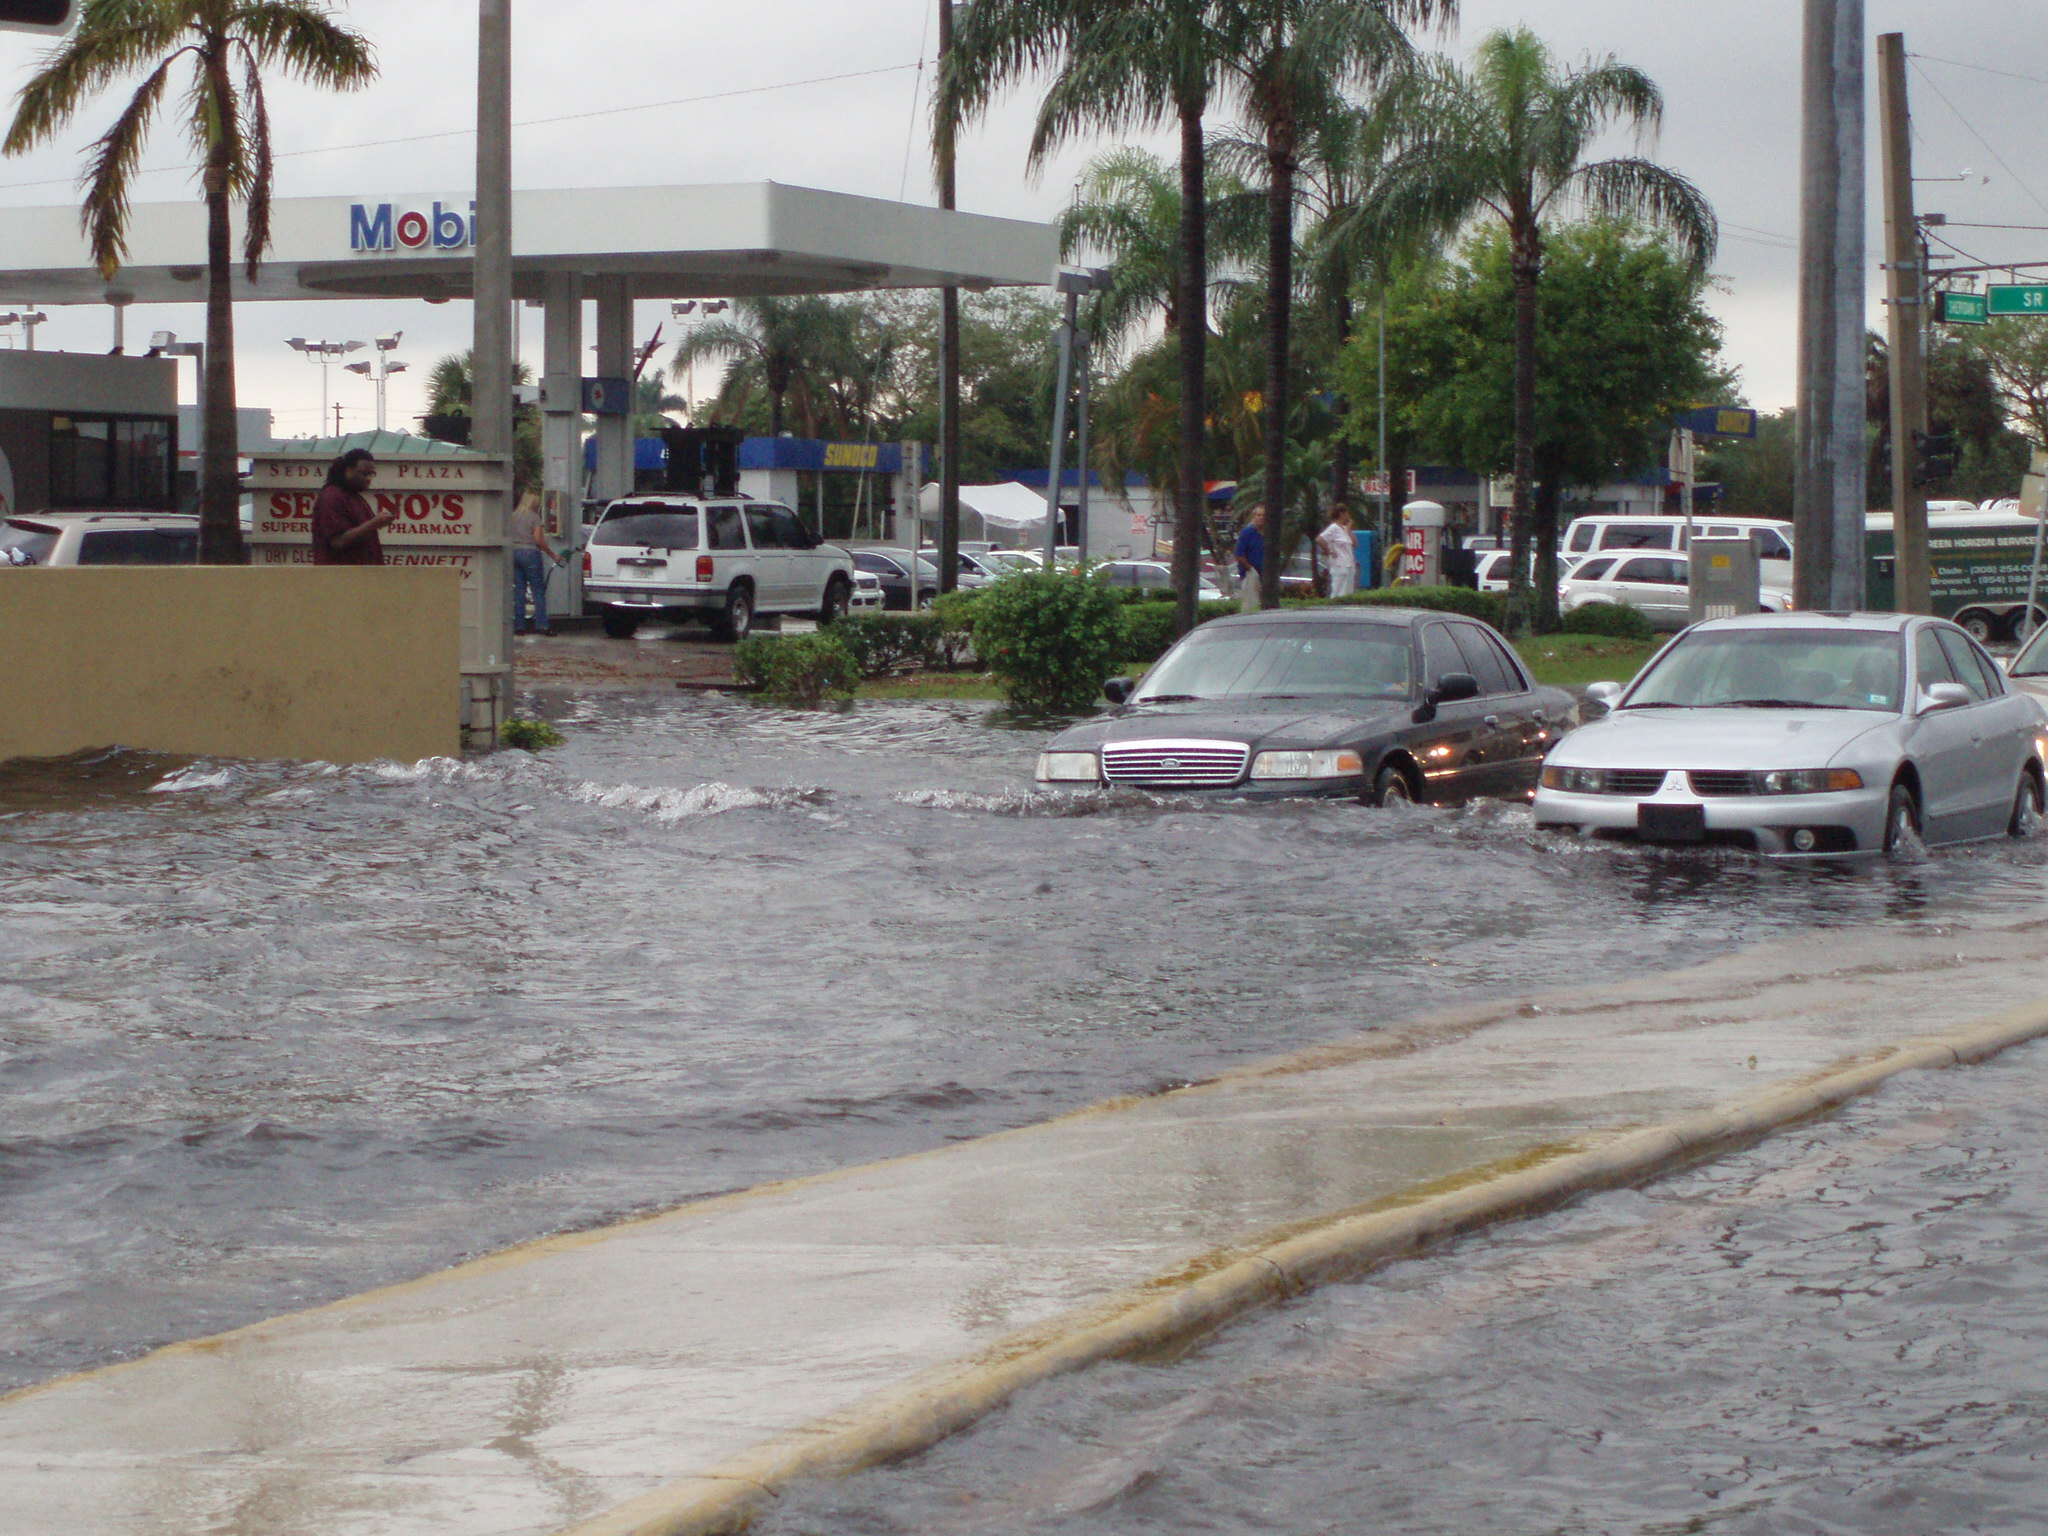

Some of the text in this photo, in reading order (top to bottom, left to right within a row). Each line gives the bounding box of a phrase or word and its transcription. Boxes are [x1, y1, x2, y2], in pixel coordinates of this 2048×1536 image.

[350, 200, 476, 250] Mobi
[2023, 292, 2043, 308] SR
[398, 464, 465, 479] PLAZA
[387, 523, 473, 535] PHARMACY
[1954, 538, 1996, 548] HORIZON
[292, 549, 314, 563] CLE
[383, 555, 473, 567] BENNETT
